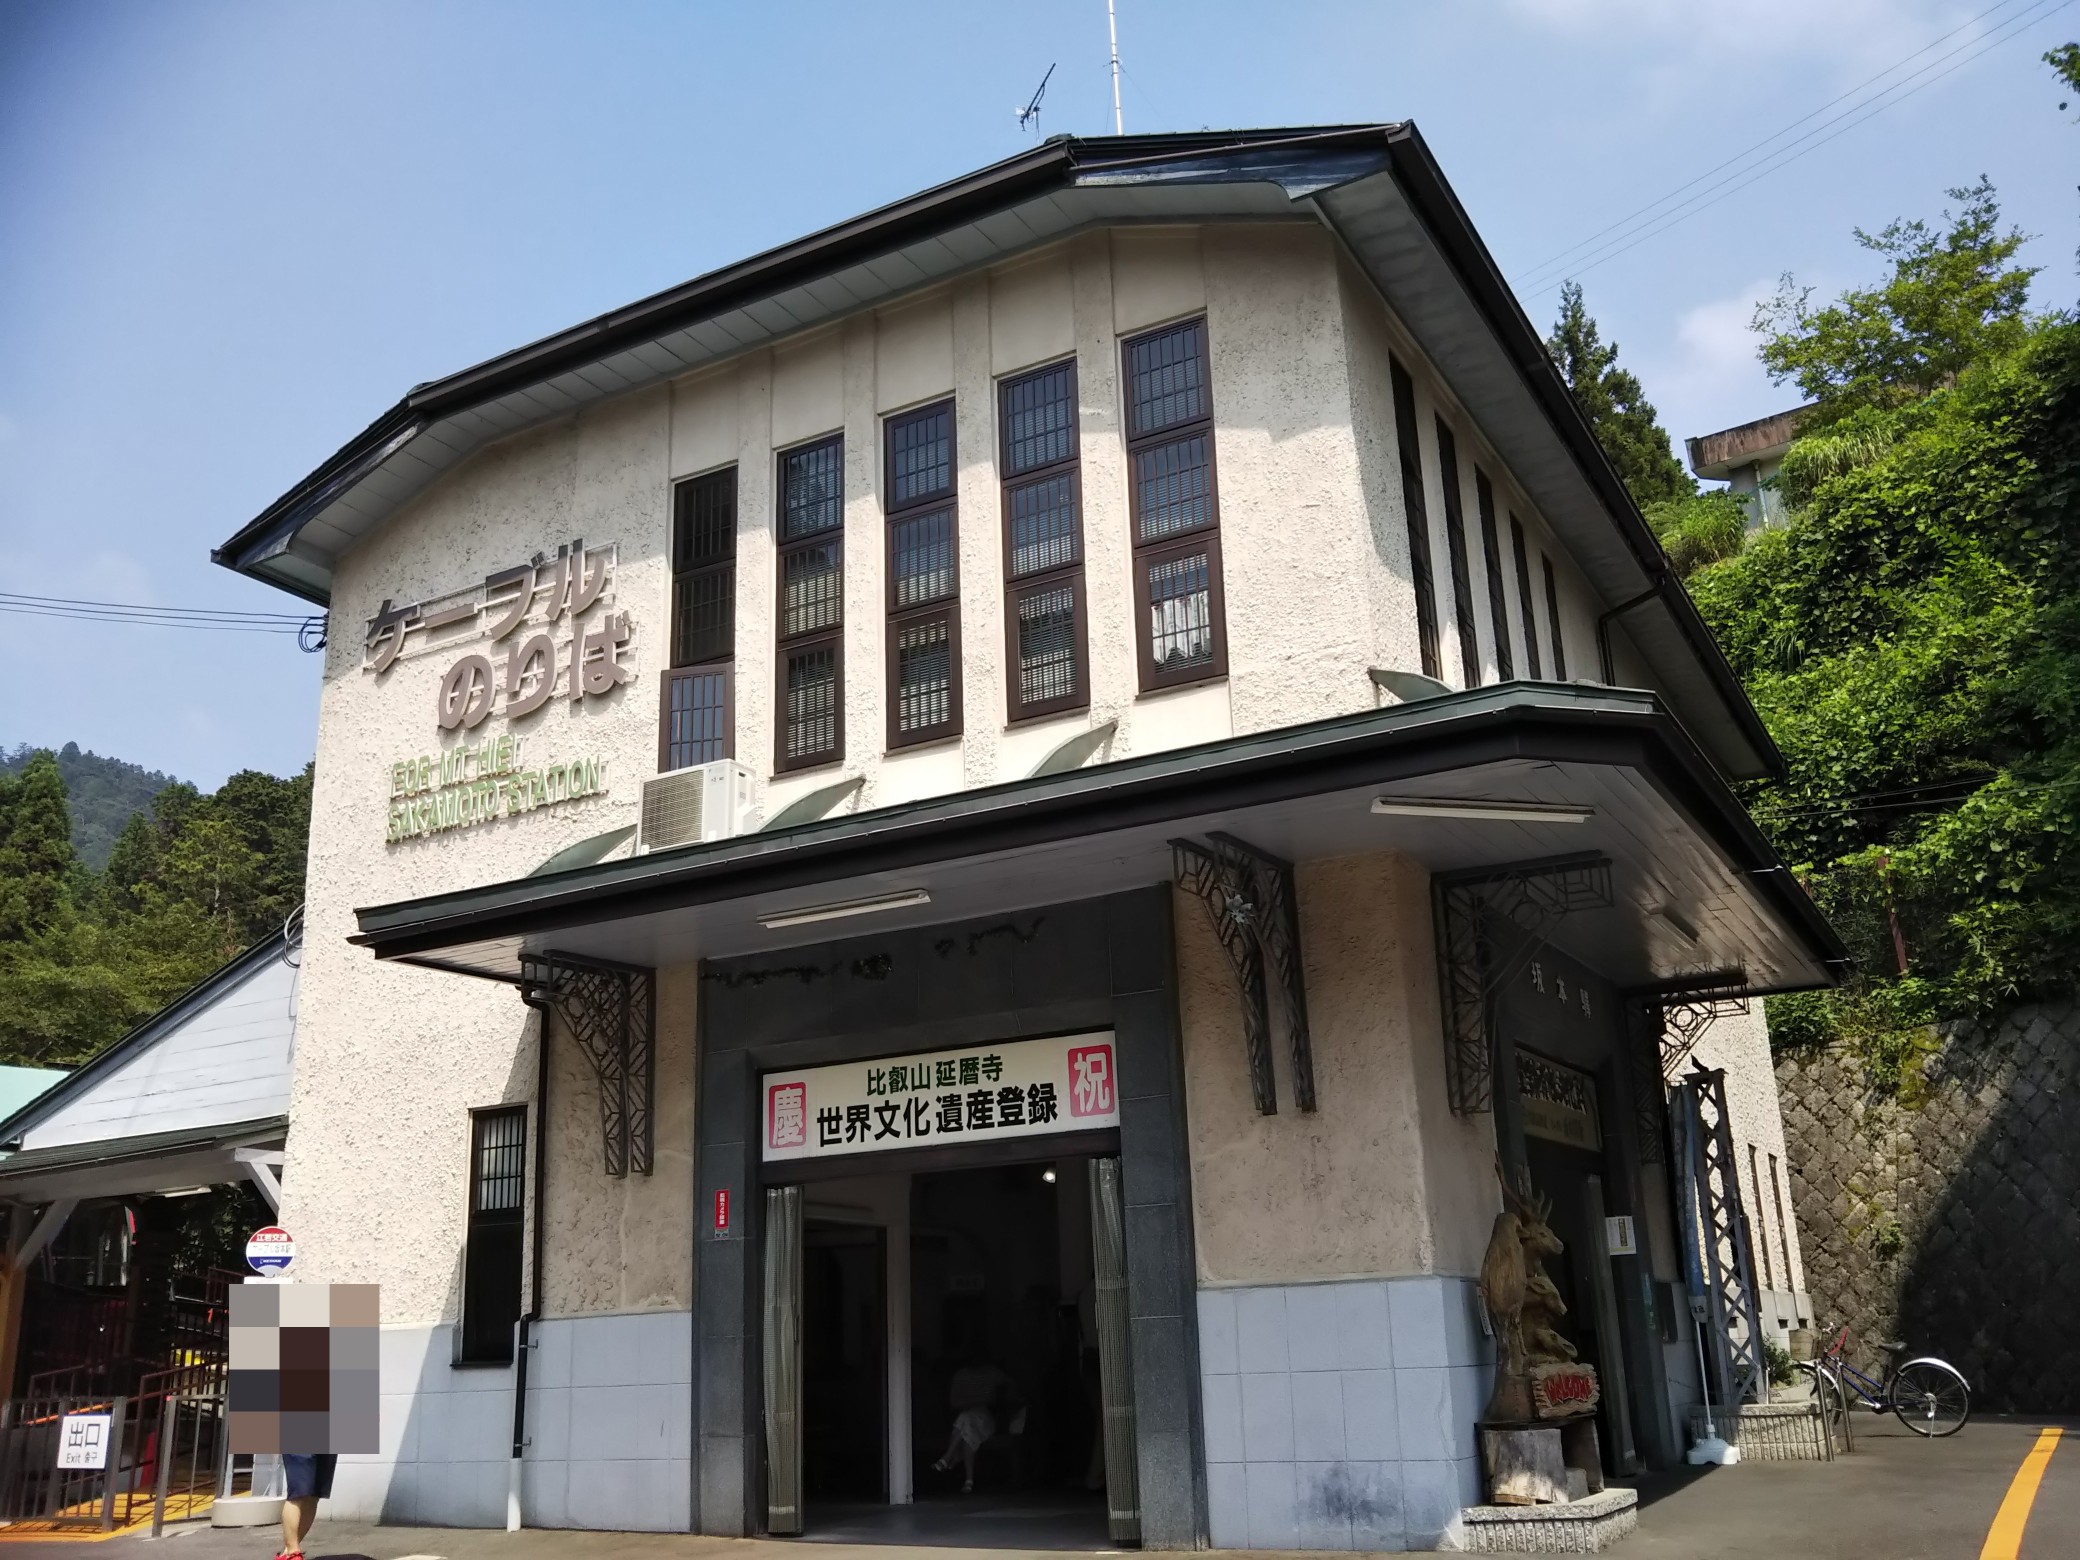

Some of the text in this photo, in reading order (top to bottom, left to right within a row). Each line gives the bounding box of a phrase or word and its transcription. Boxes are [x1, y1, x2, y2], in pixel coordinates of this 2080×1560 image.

[366, 538, 606, 673] ケーブル
[438, 610, 631, 729] のりば
[391, 733, 519, 798] FOR MT HIEI
[386, 754, 601, 843] SAKAMOTO STATION
[866, 1053, 1003, 1097] 比叡山延暦寺
[1073, 1052, 1111, 1113] 祝
[772, 1086, 804, 1146] 慶
[816, 1082, 1058, 1148] 世界文化遺産登録
[66, 1452, 81, 1464] Exit
[68, 1421, 101, 1448] 出口
